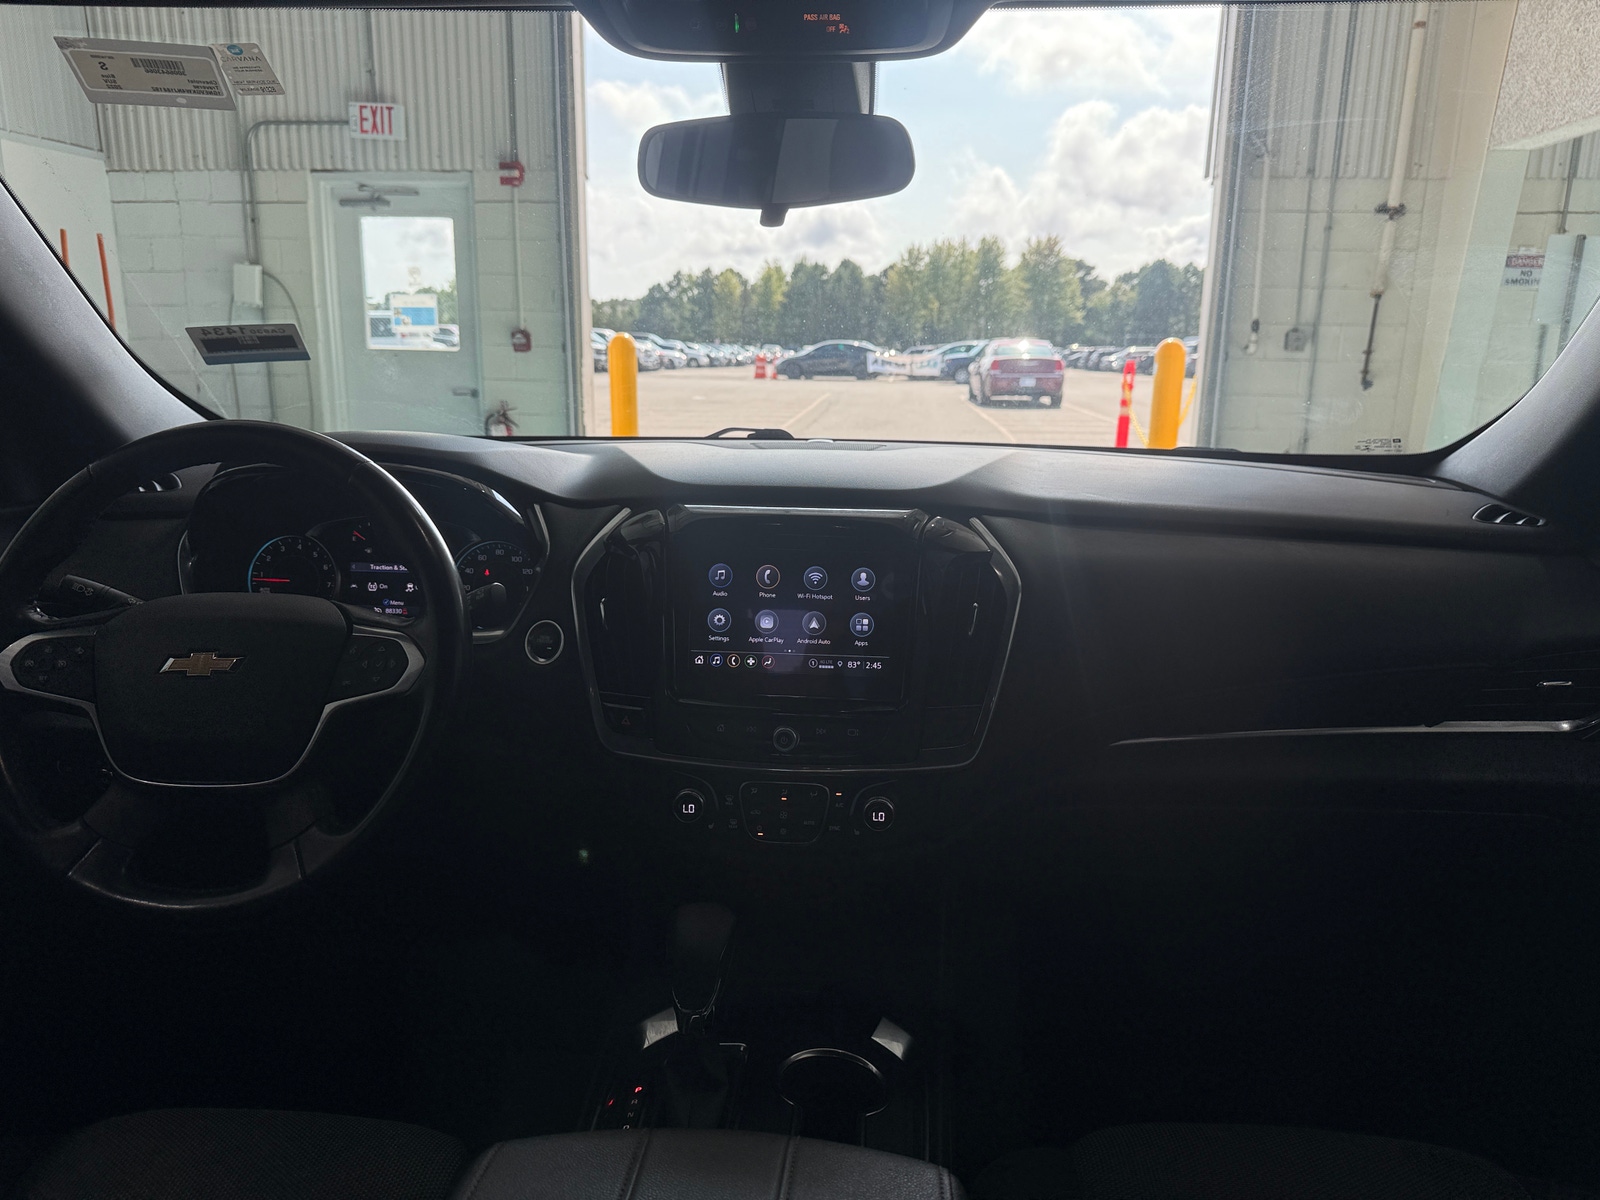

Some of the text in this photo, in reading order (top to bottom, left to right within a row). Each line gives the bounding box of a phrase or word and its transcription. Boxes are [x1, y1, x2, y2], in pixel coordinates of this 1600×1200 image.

[359, 104, 394, 136] EXIT
[1512, 257, 1544, 266] DANGER
[708, 635, 730, 643] Settings
[682, 803, 695, 814] LO
[872, 811, 885, 822] LO
